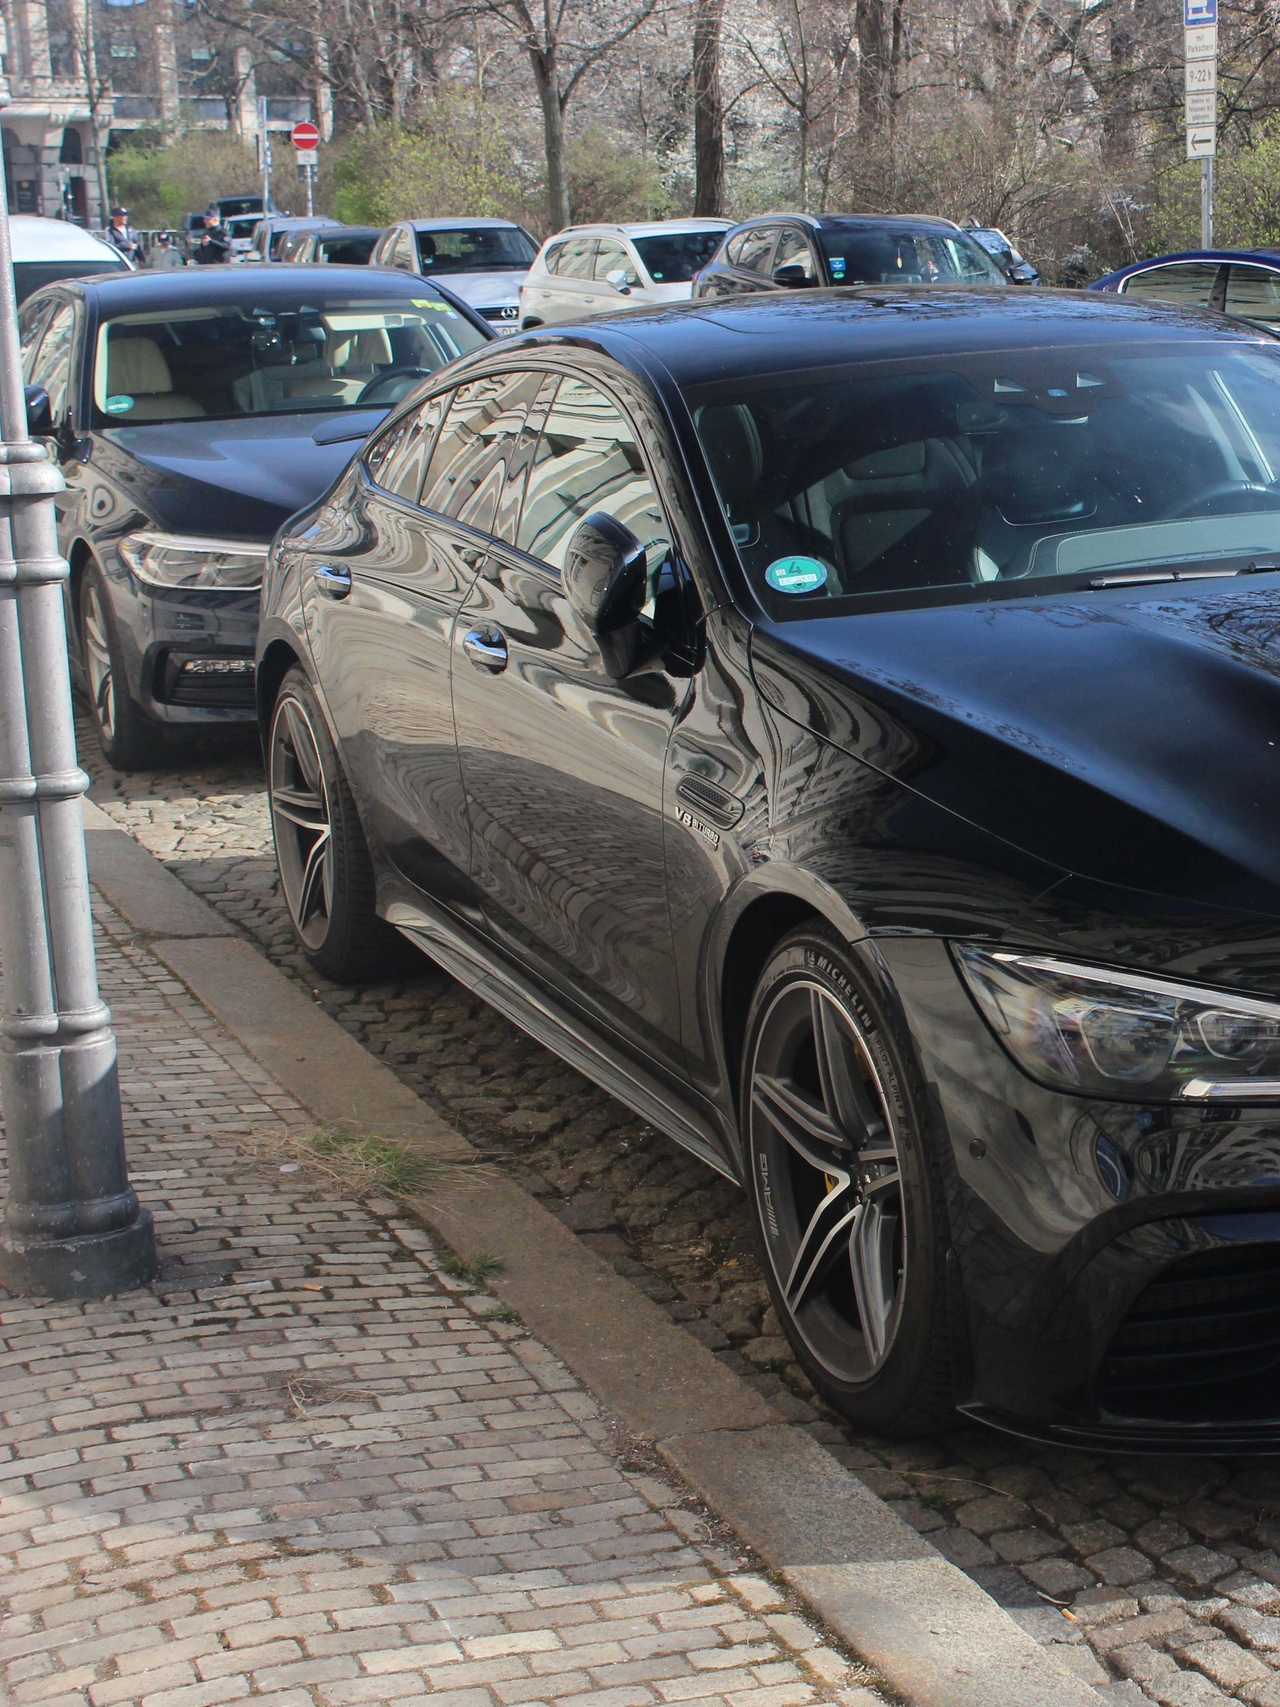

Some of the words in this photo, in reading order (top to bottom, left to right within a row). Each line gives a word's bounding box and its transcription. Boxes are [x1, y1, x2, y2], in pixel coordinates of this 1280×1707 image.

[1187, 43, 1213, 53] Parkschein
[1190, 69, 1206, 83] 9-22
[1207, 68, 1211, 81] h
[788, 561, 803, 575] 4
[675, 806, 693, 828] V8
[692, 818, 720, 843] BITURBO
[816, 955, 873, 1029] MICHELIN
[875, 1040, 890, 1067] PILOT
